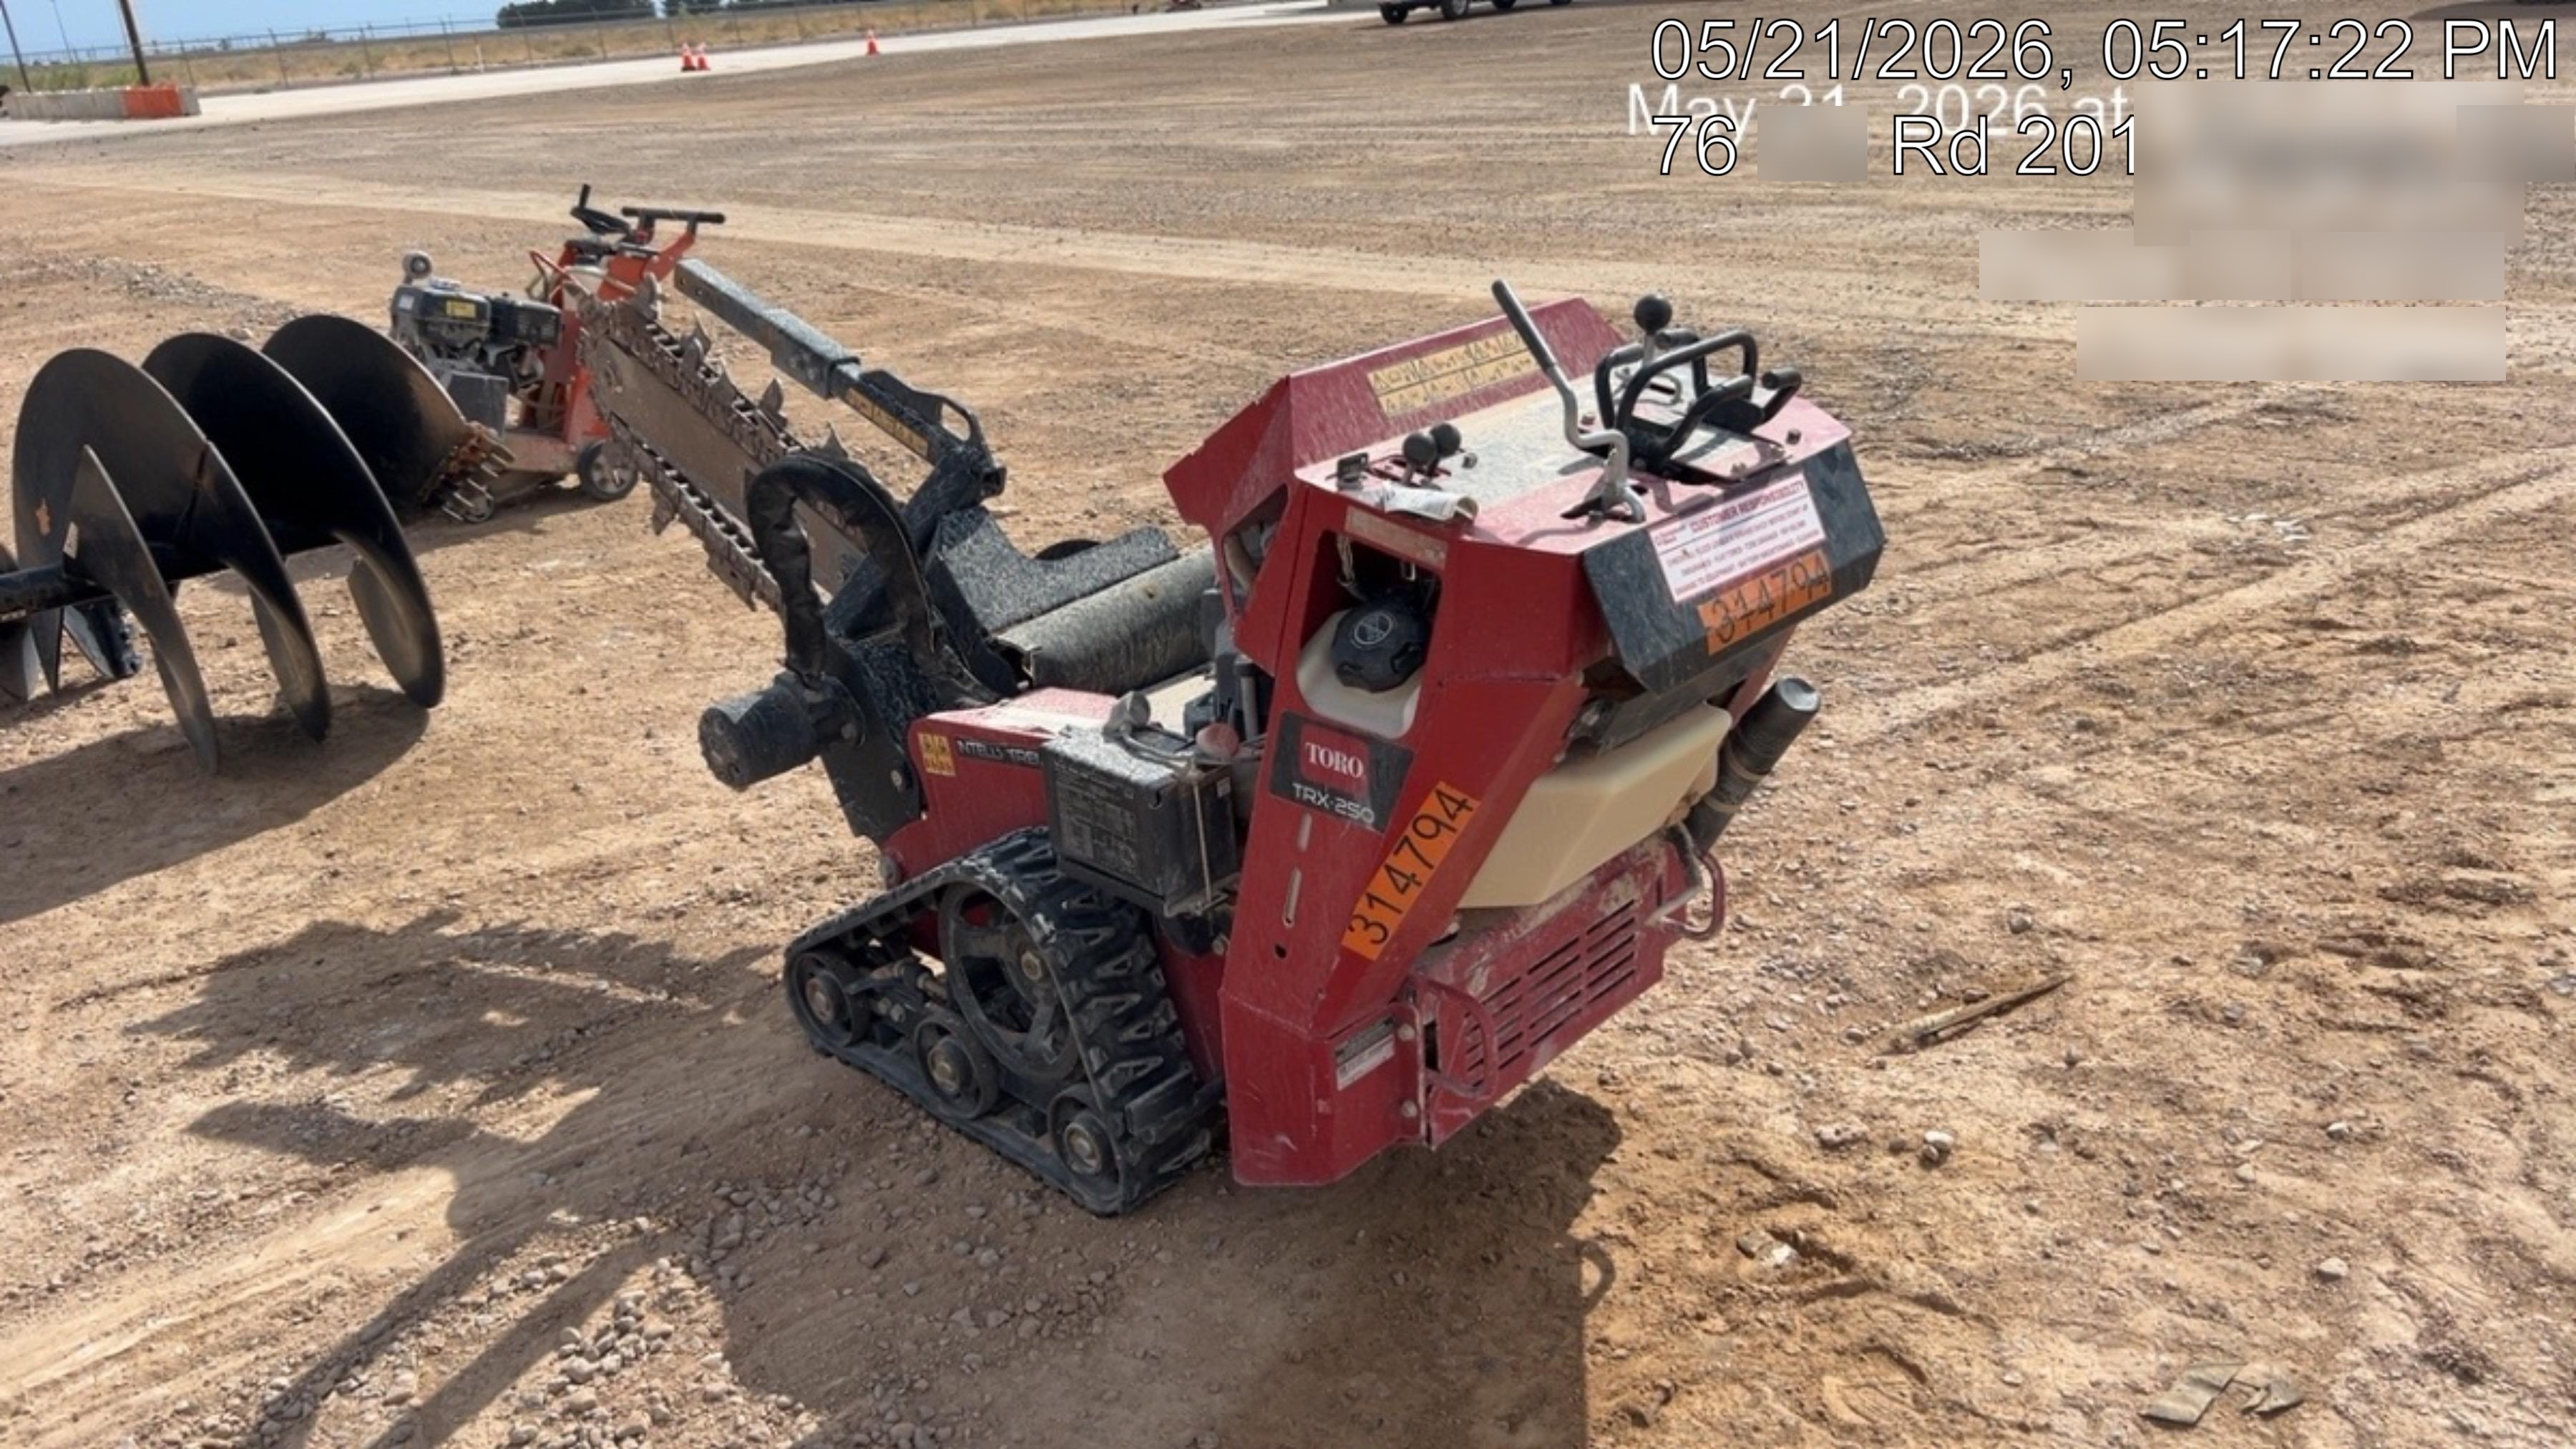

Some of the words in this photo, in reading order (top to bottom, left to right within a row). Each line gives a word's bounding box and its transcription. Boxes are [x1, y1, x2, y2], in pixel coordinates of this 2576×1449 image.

[1713, 552, 1830, 643] 314794
[1304, 741, 1365, 779] TORO
[1292, 781, 1375, 825] TRX-250
[1348, 789, 1474, 946] 314794
